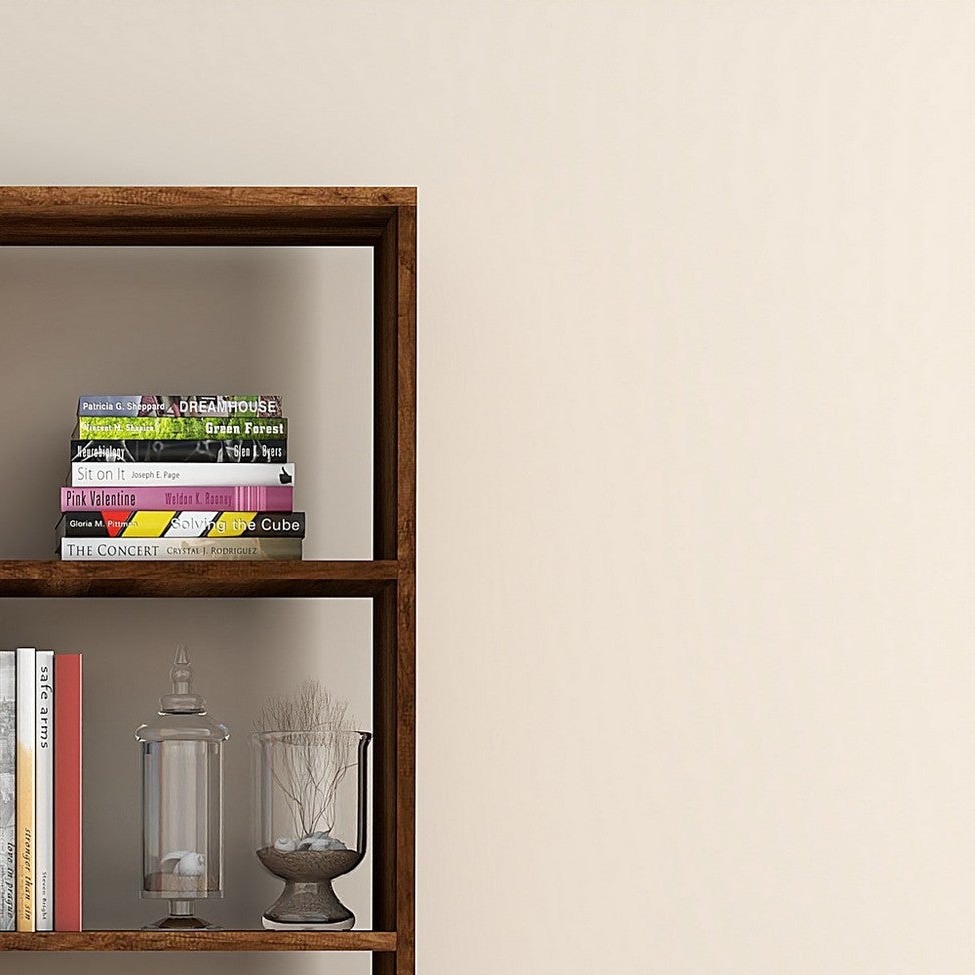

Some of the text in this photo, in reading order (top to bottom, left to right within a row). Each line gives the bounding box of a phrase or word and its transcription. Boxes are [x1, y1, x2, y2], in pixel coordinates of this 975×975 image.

[83, 402, 165, 411] Patricia G. Sheppard
[180, 400, 276, 413] DREAMHOUSE
[206, 422, 283, 434] Green Forest
[234, 444, 250, 457] Glen
[78, 467, 125, 480] Sit on It
[132, 471, 154, 480] Joseph
[164, 472, 180, 480] Page
[66, 491, 135, 506] Pink Valentine
[165, 492, 192, 504] Weldon
[196, 492, 202, 504] K.
[171, 518, 300, 533] Solving the Cube
[67, 544, 159, 556] THE CONCERT
[40, 666, 52, 748] safe arms
[7, 842, 15, 864] love
[23, 828, 32, 872] stronger
[7, 868, 14, 878] in
[24, 876, 32, 900] than
